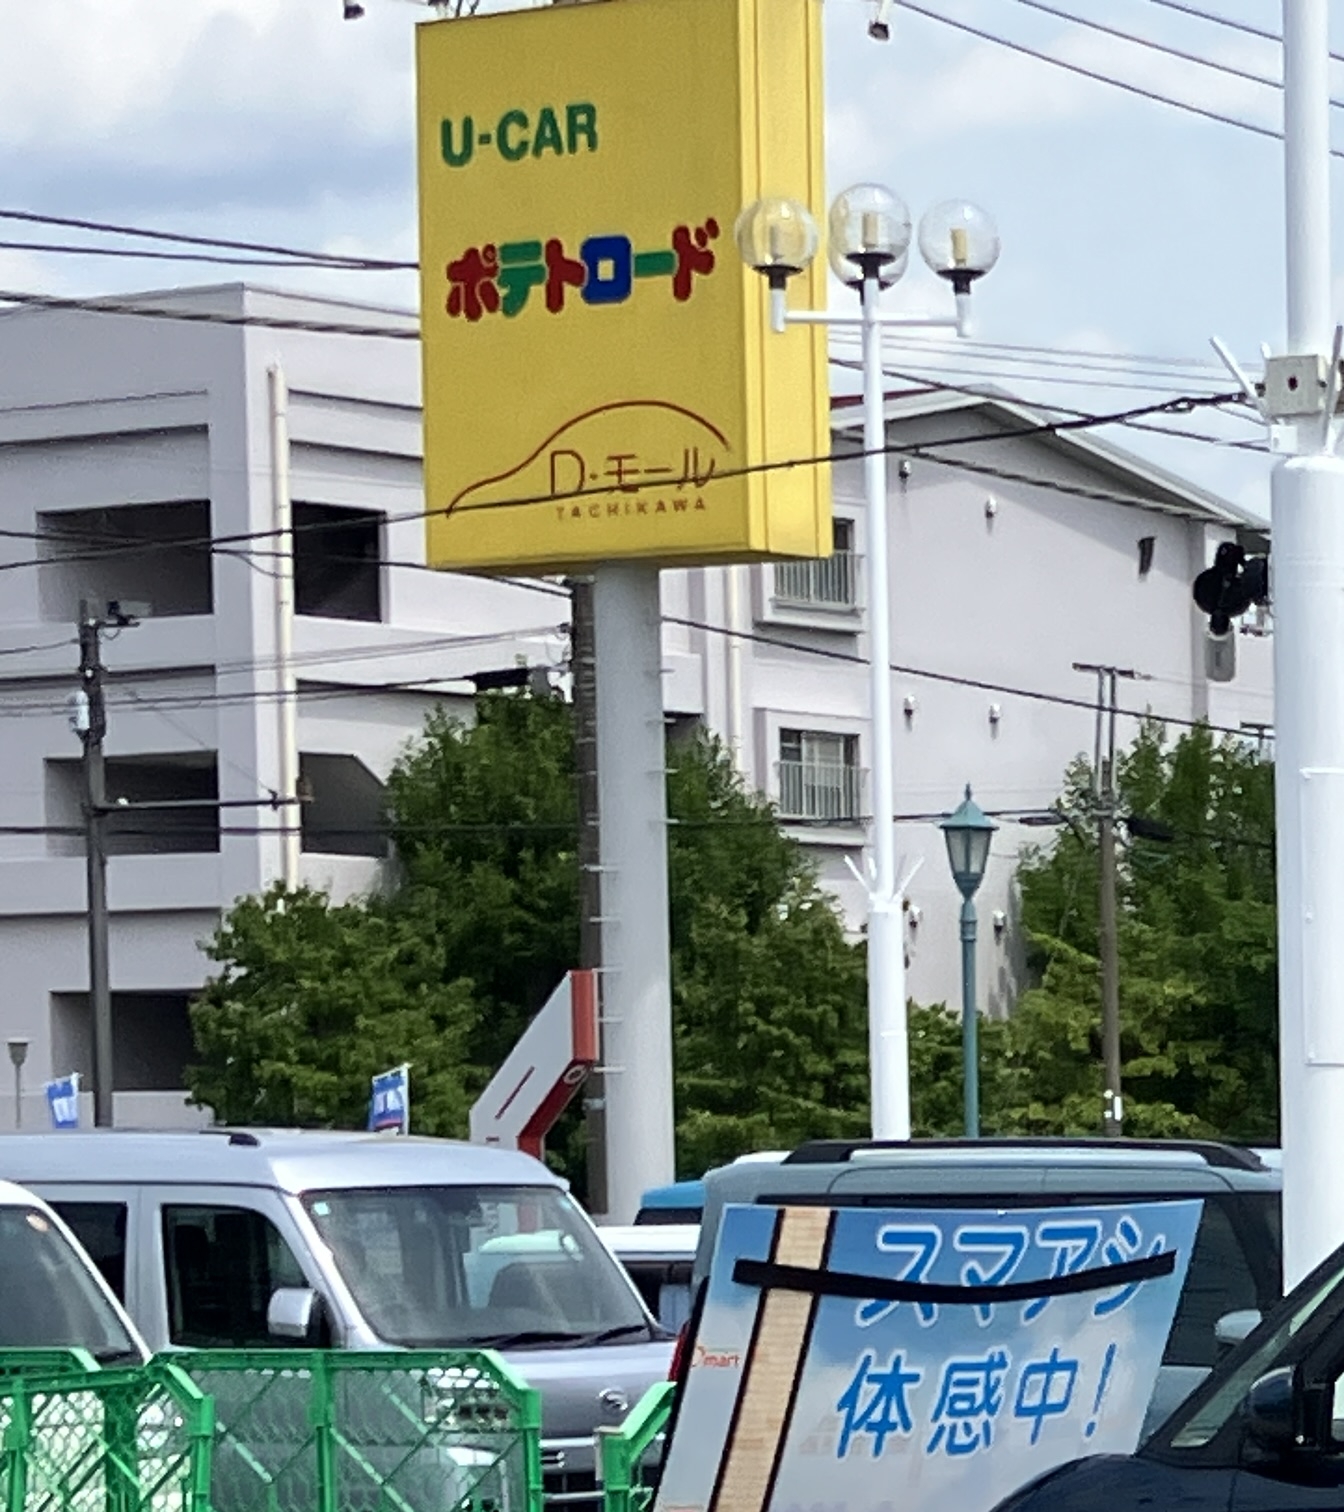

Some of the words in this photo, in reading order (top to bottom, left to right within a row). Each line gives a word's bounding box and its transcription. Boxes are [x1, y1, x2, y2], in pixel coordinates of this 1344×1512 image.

[441, 102, 598, 167] U-CAR
[446, 218, 719, 322] ポテトロード
[556, 497, 706, 520] TACHIKAWA
[857, 1217, 1166, 1325] スマアシ
[836, 1342, 1117, 1459] 体感中!
